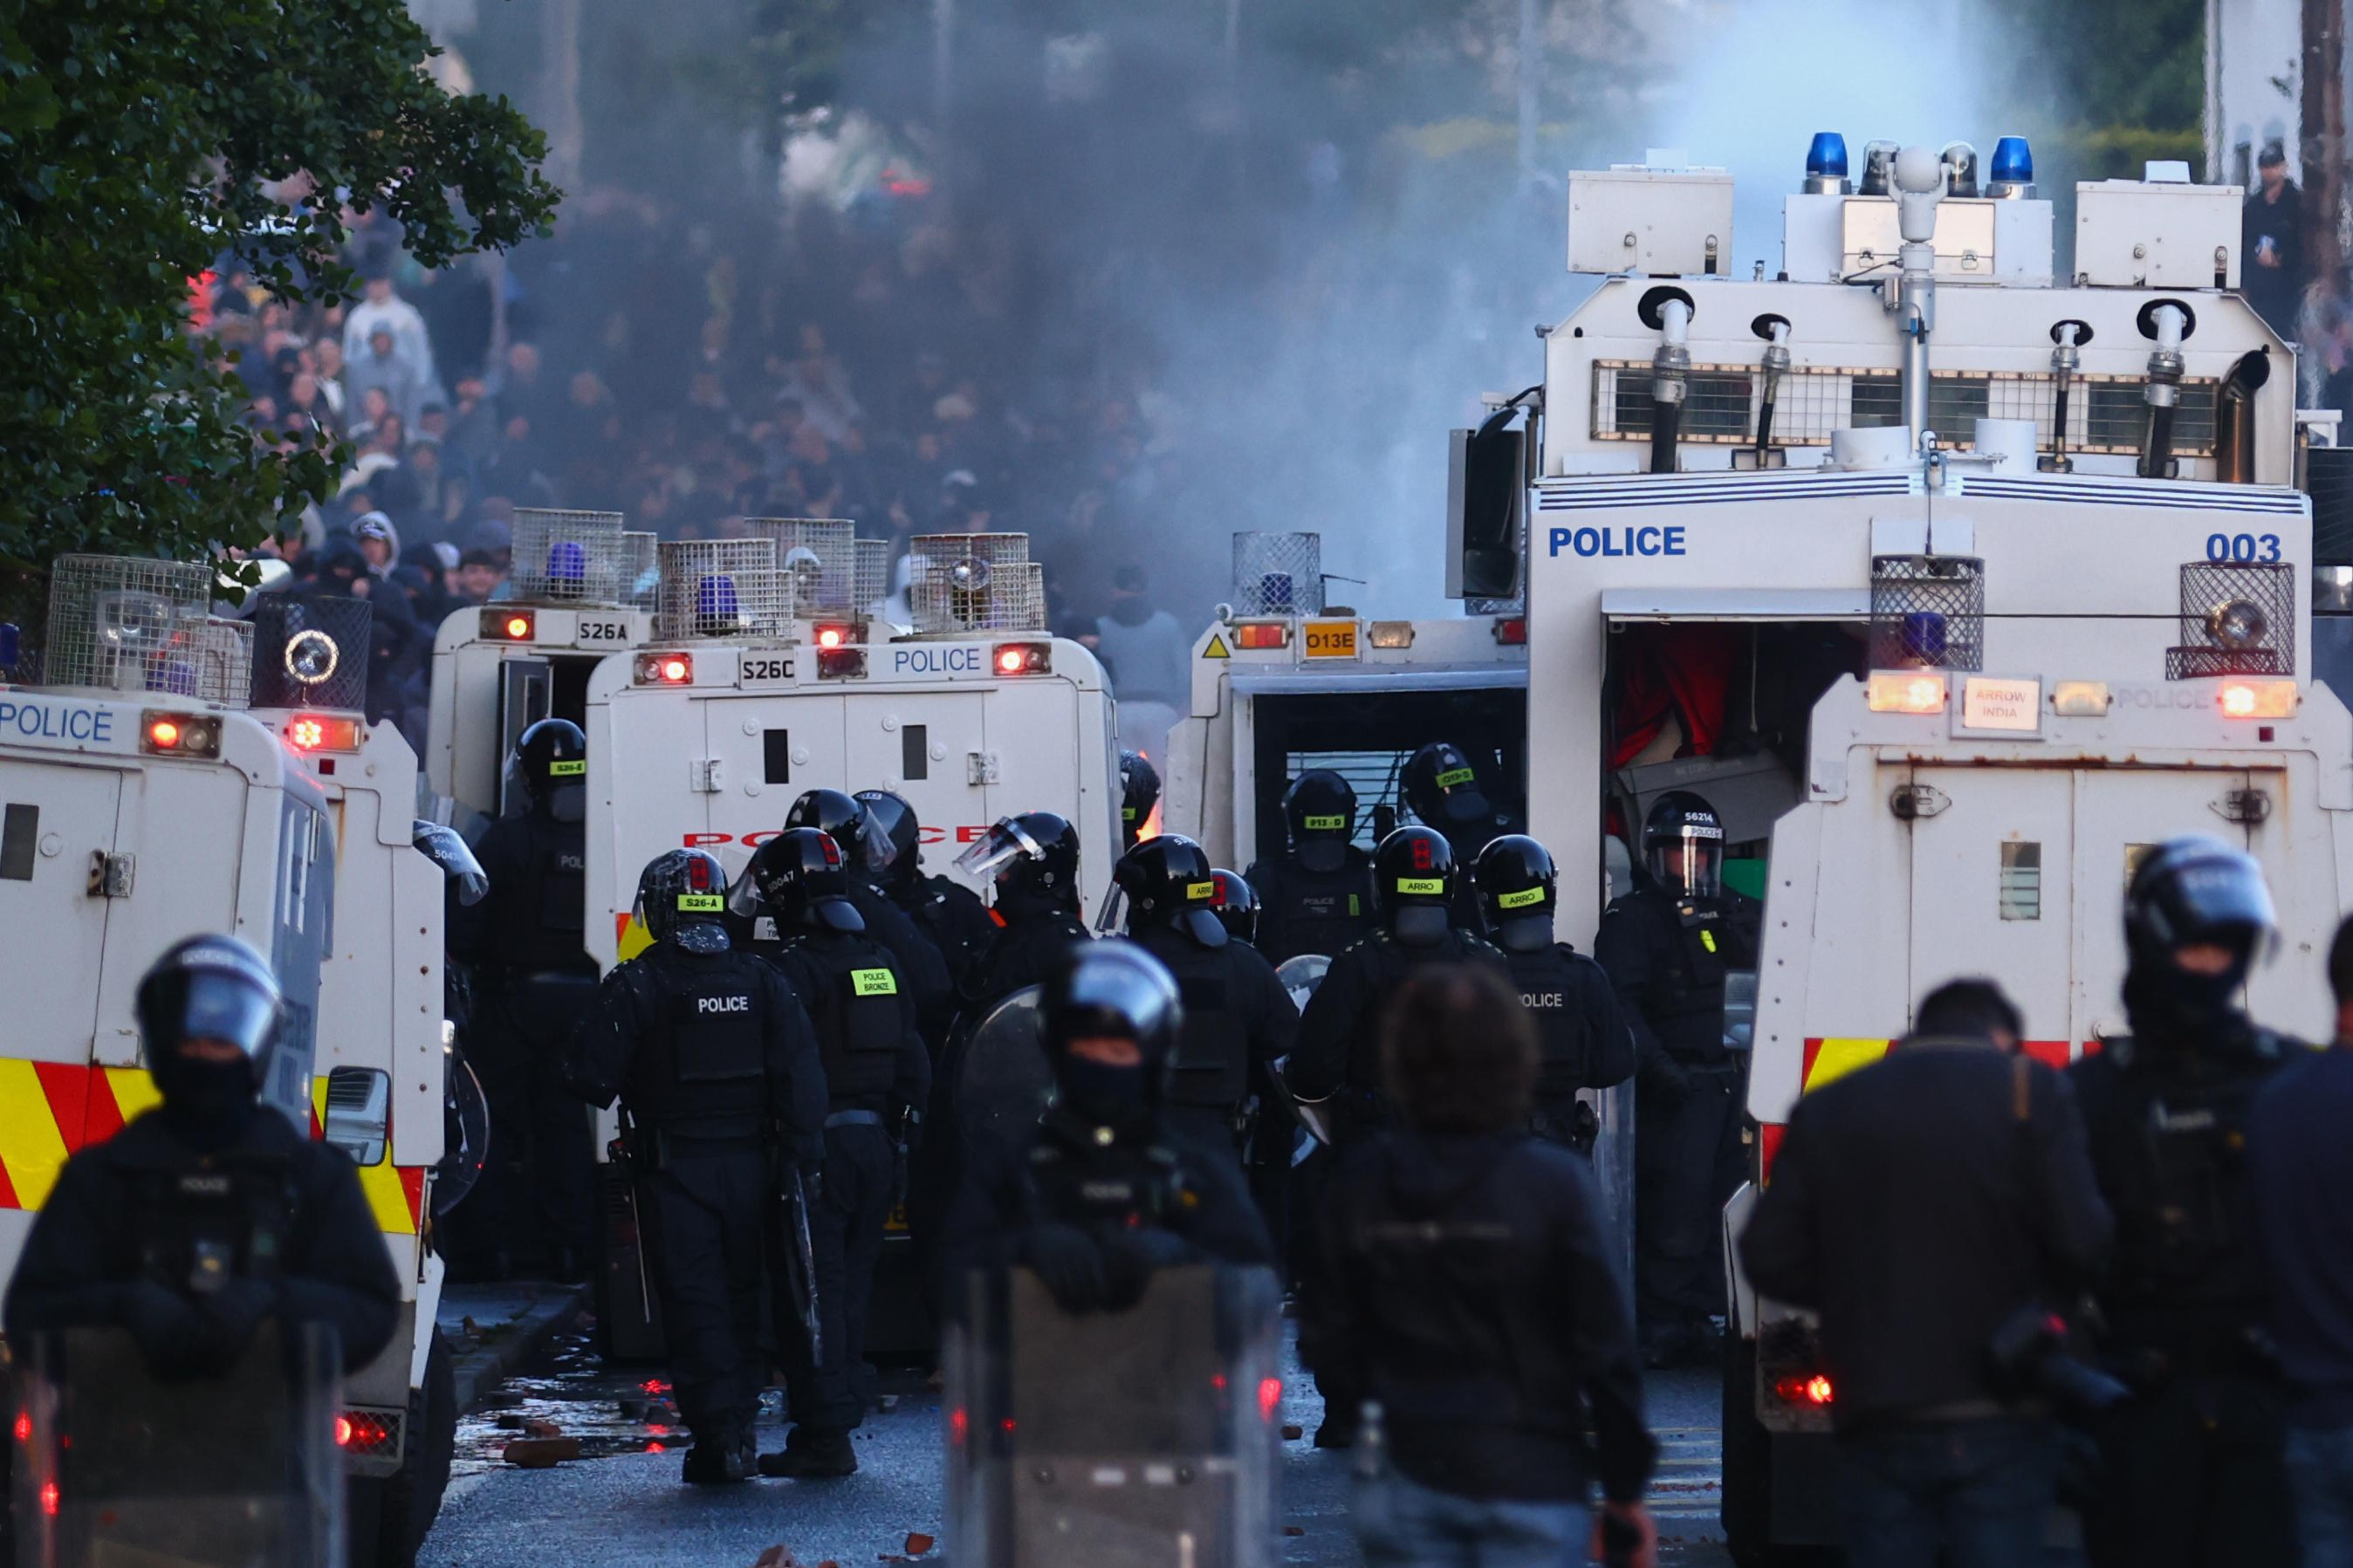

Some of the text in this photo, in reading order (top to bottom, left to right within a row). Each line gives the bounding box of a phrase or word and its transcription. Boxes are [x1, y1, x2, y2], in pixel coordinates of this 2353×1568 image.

[1549, 526, 1686, 557] POLICE
[2206, 533, 2281, 563] 003
[580, 623, 628, 640] S26A
[895, 648, 981, 673] POLICE
[743, 661, 794, 680] S26C
[1976, 688, 2026, 702] ARROW
[2117, 688, 2209, 709] POLICE
[1982, 707, 2018, 718] INDIA
[0, 702, 113, 742] POLICE
[1684, 811, 1713, 822] 56214
[560, 855, 585, 869] POL
[1407, 882, 1434, 891] ARRO
[686, 898, 717, 907] S26-A
[1508, 893, 1535, 905] ARRO
[863, 972, 887, 982] POLICE
[864, 982, 889, 992] BRONZE
[698, 996, 749, 1013] POLICE
